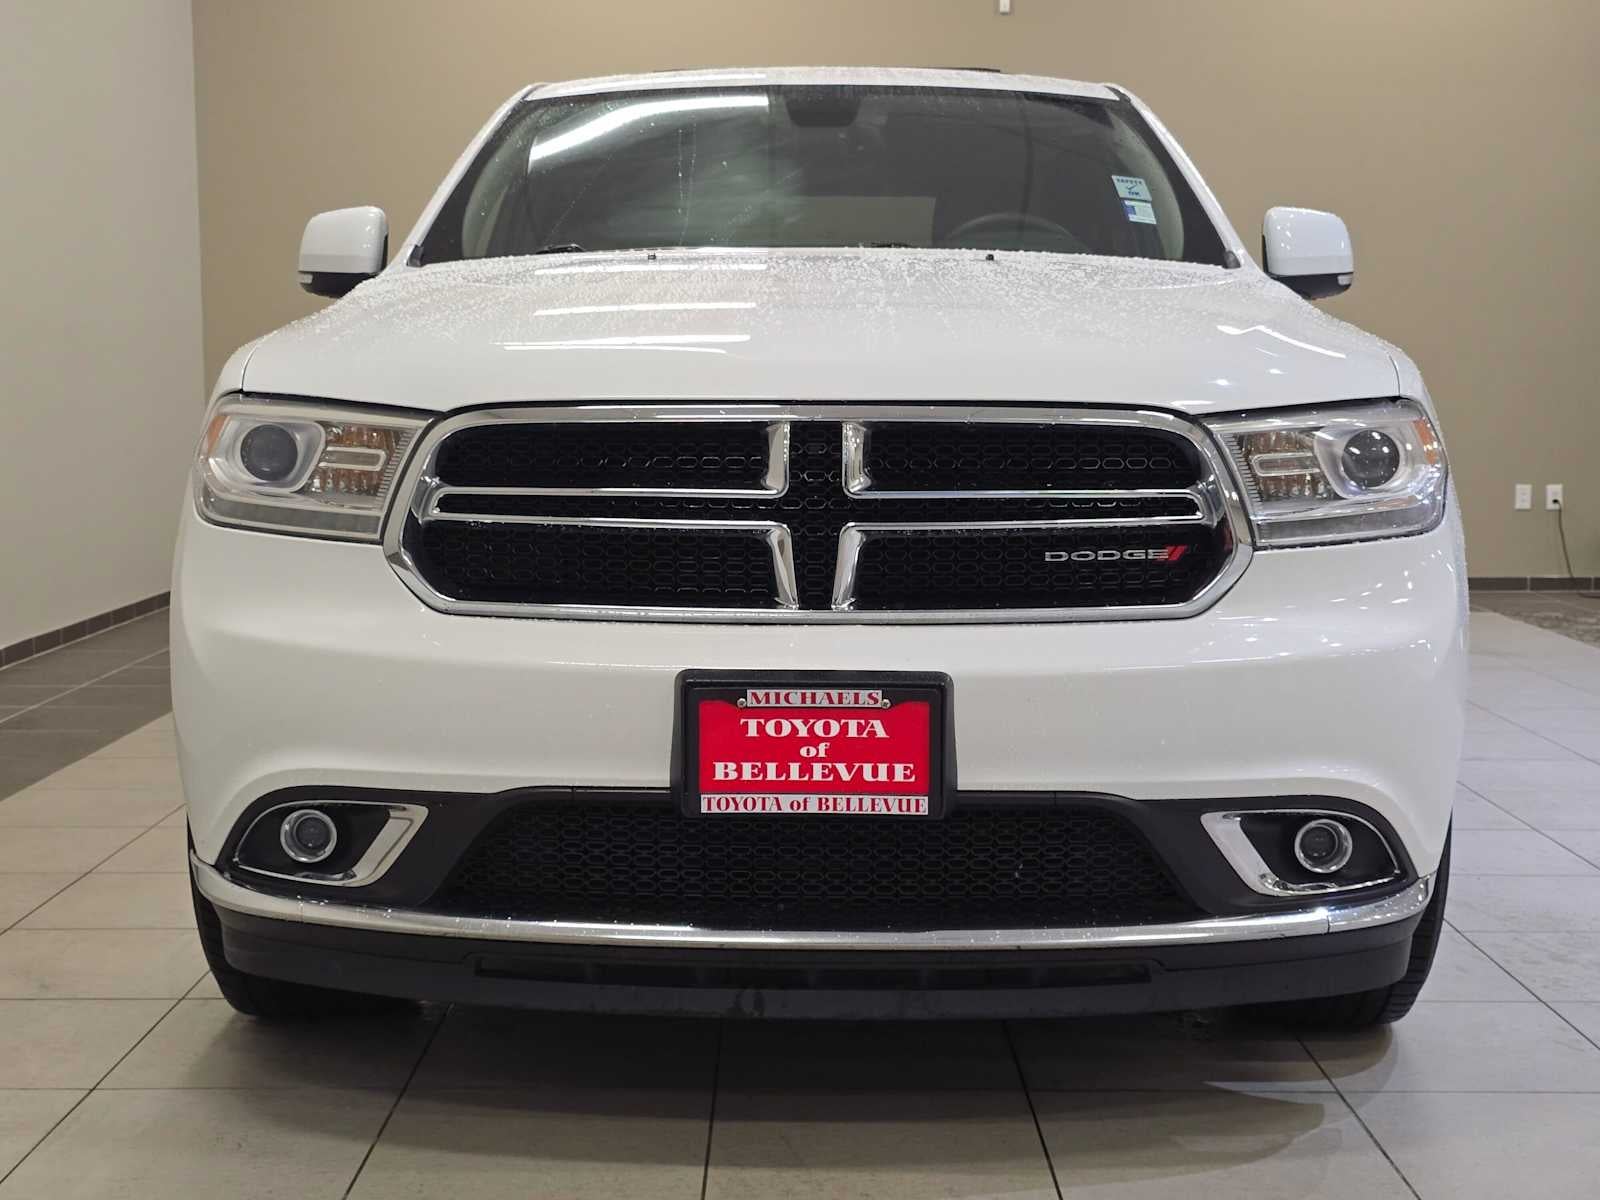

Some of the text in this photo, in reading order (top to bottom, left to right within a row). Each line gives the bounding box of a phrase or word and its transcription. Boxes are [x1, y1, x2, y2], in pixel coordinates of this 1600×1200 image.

[1044, 549, 1169, 562] DODGE
[750, 691, 880, 706] MICHAELS
[739, 718, 890, 738] TOYOTA
[799, 742, 831, 758] of
[712, 761, 917, 783] BELLEVUE
[702, 795, 927, 814] TOYOTA of BELLEVUE
